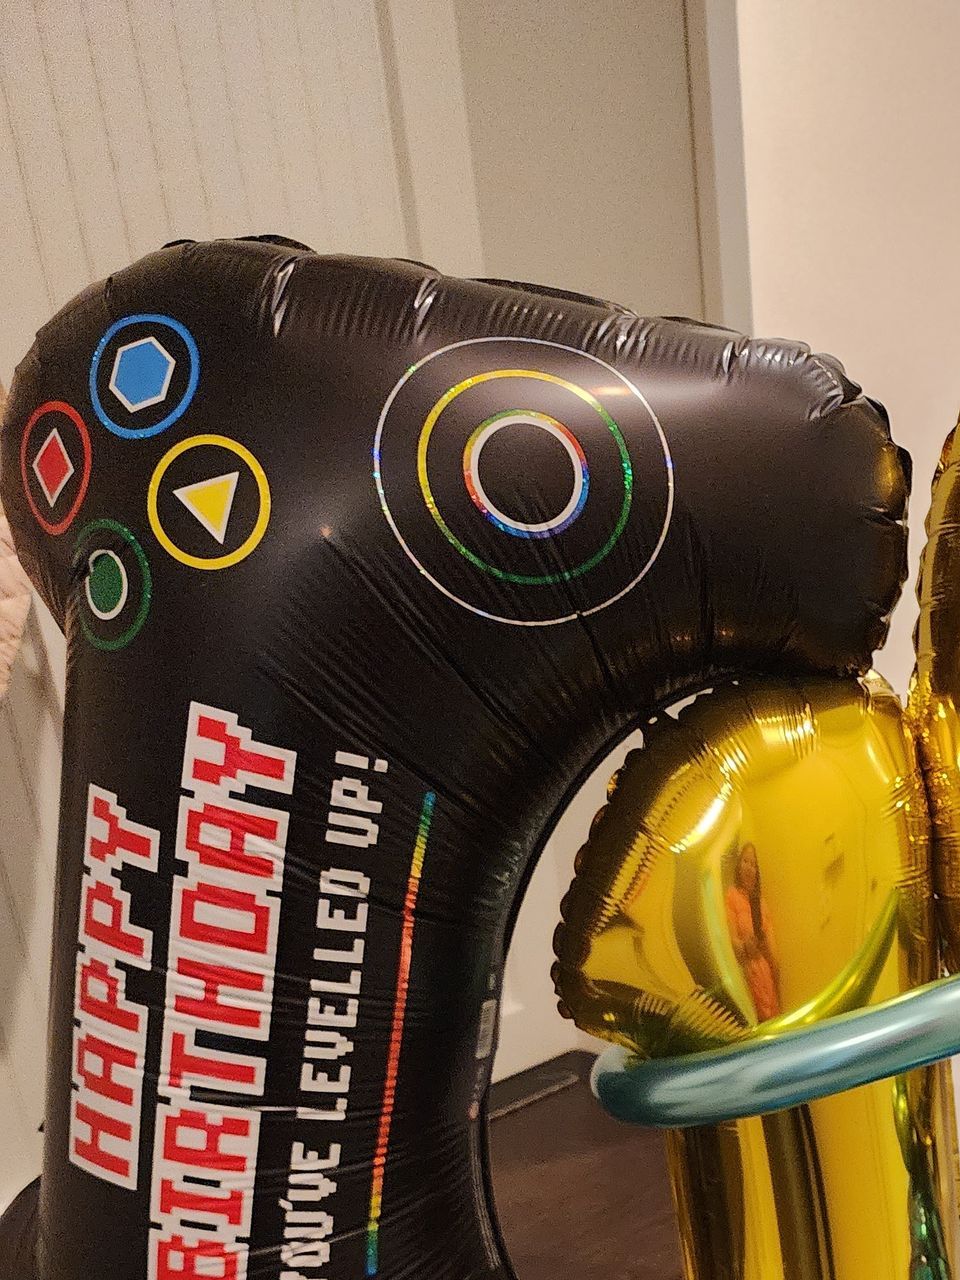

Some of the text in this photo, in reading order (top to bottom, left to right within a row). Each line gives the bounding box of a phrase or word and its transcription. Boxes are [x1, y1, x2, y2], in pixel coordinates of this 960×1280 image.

[326, 750, 389, 851] UP!
[69, 783, 160, 1191] HAPPY
[297, 869, 371, 1121] LEVELLED
